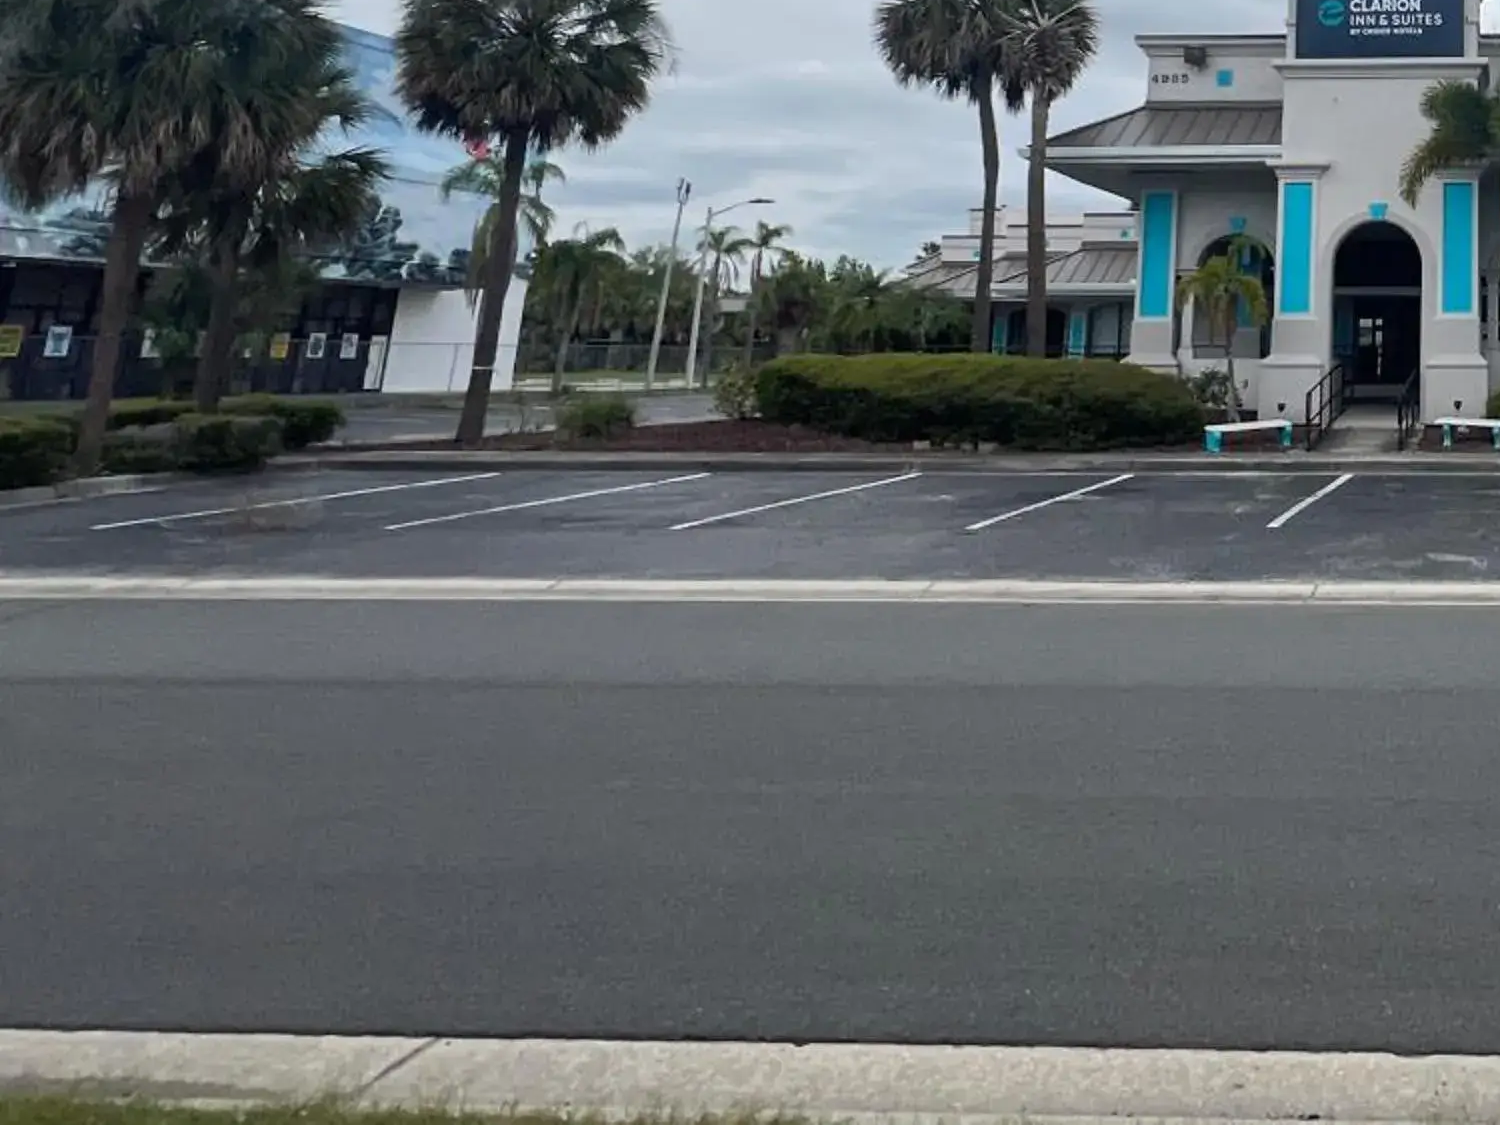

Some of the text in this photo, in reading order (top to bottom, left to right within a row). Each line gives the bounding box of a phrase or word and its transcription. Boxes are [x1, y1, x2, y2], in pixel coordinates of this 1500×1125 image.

[1350, 13, 1443, 26] INN & SUITES
